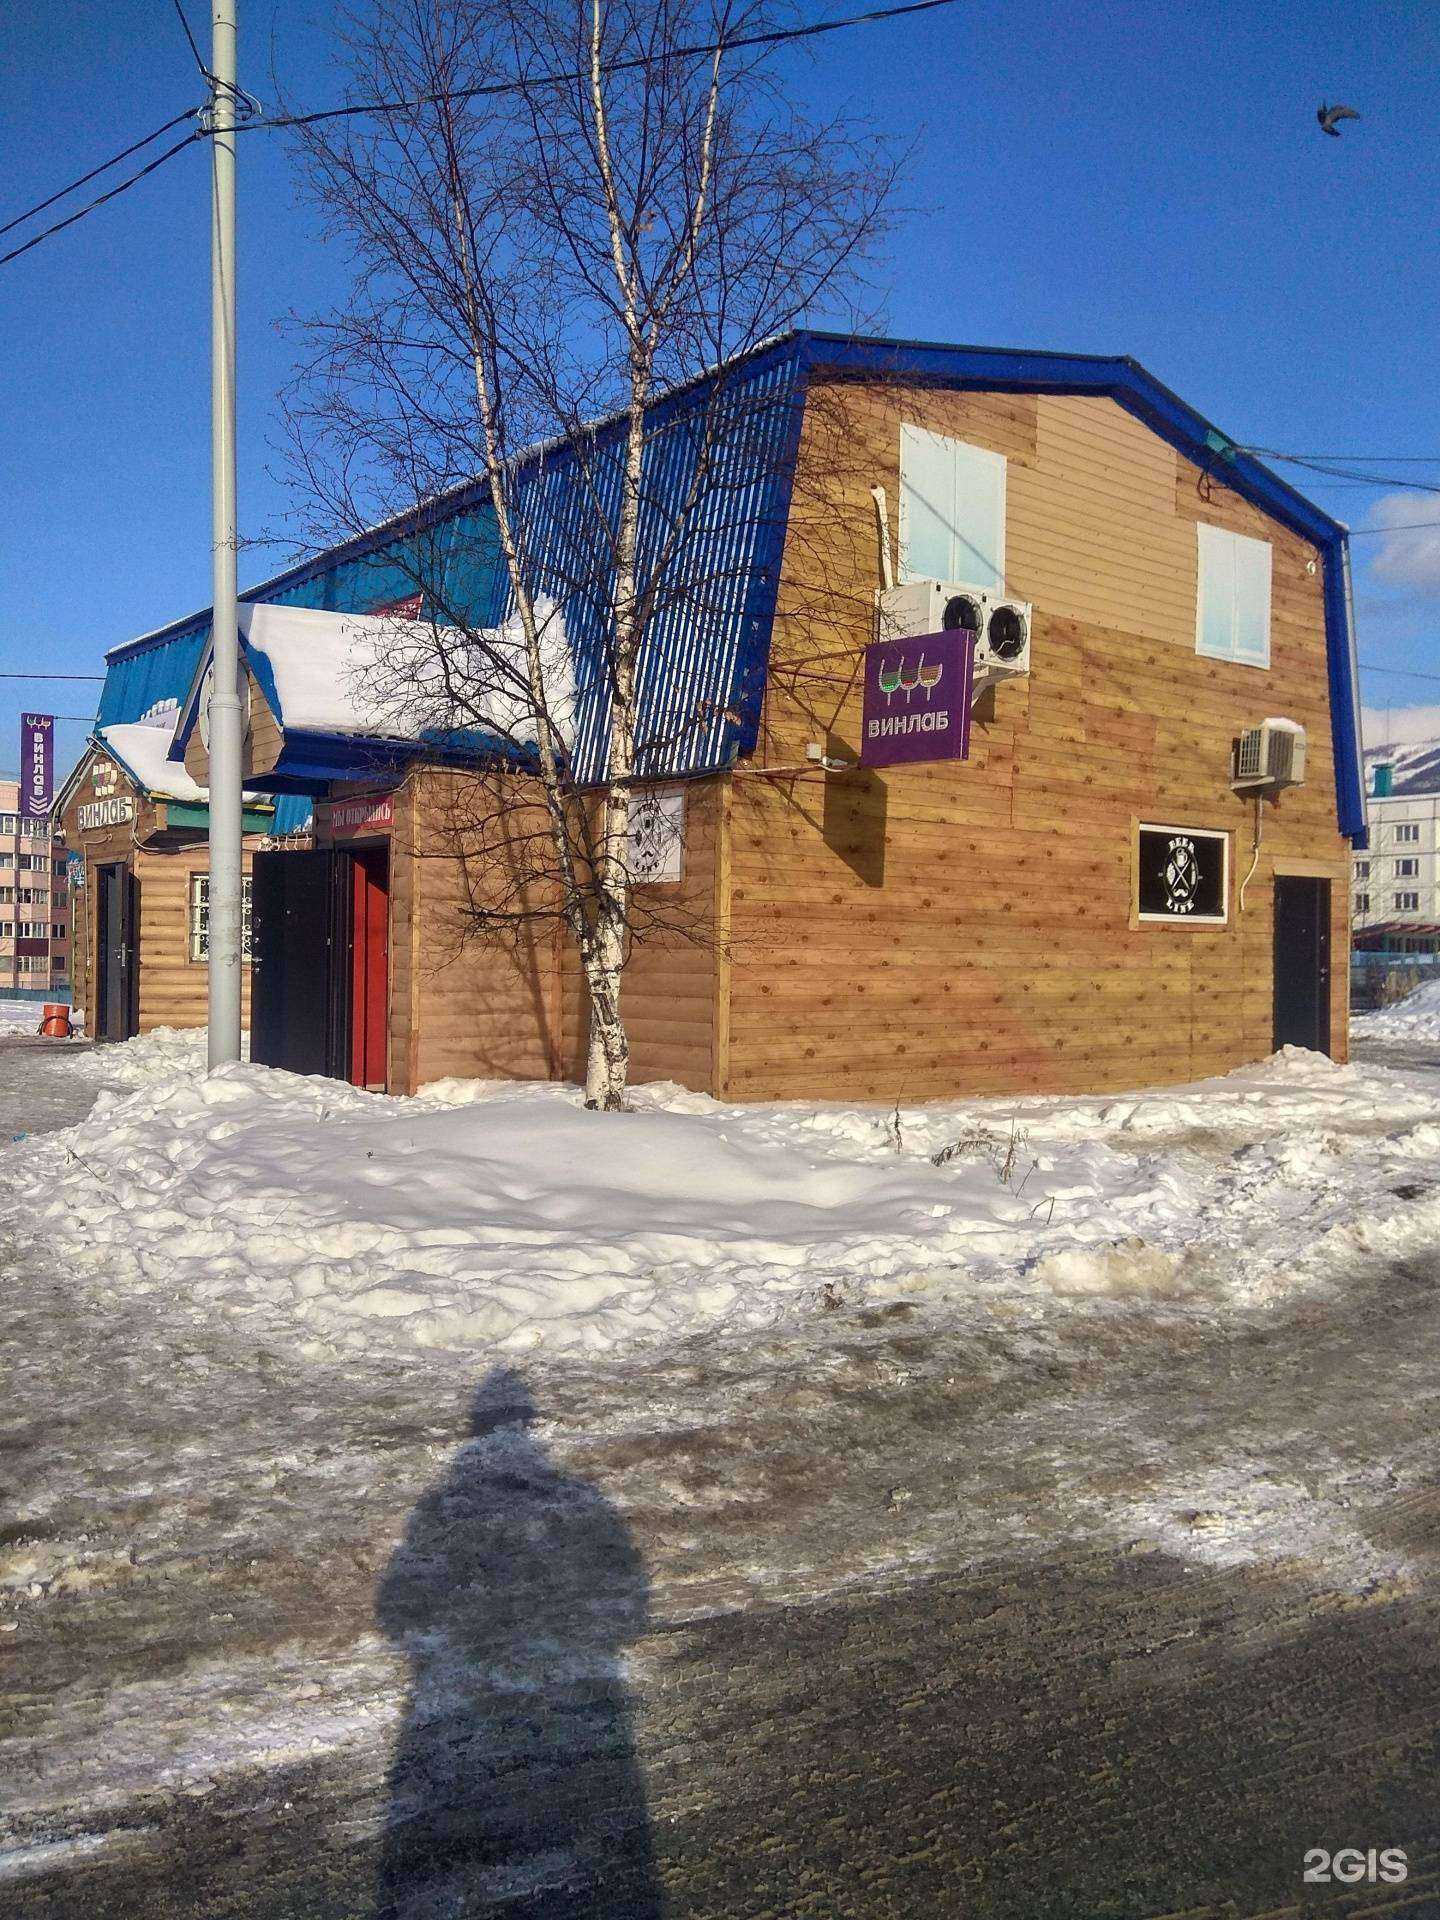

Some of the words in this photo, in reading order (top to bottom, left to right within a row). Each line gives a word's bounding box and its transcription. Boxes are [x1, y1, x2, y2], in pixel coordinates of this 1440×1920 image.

[868, 710, 950, 738] ВИНЛАБ
[33, 732, 45, 796] ВИНЛАБ
[78, 797, 133, 831] ВИНЛАБ
